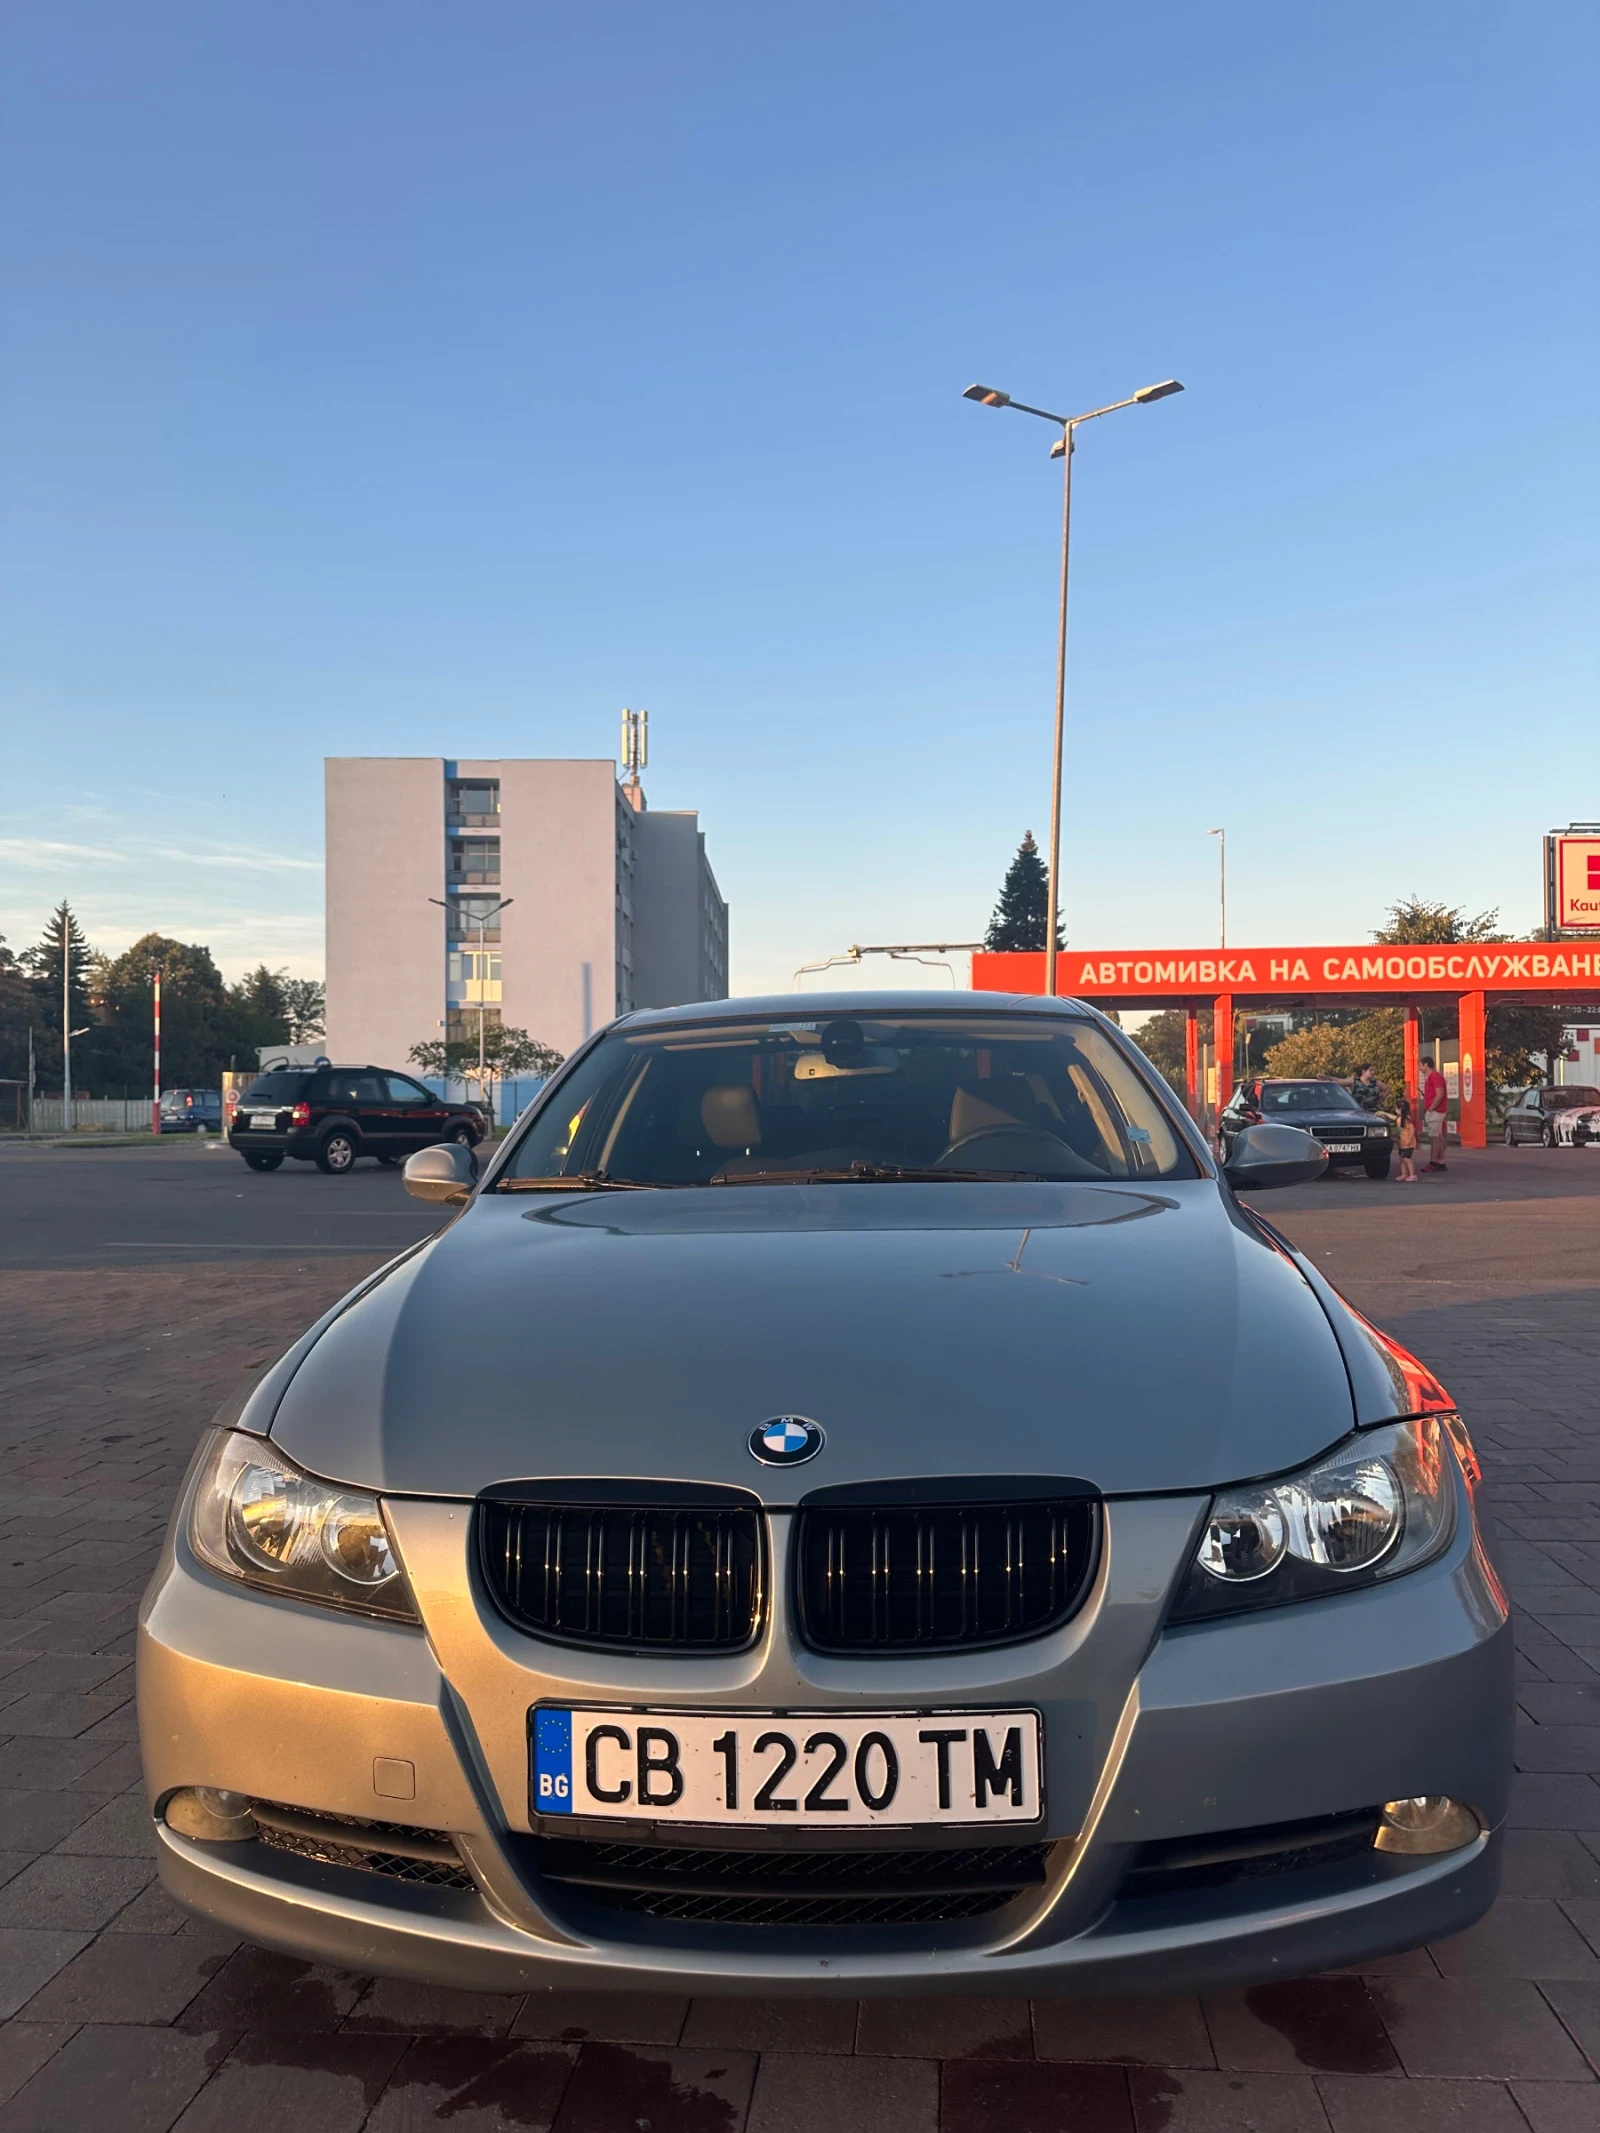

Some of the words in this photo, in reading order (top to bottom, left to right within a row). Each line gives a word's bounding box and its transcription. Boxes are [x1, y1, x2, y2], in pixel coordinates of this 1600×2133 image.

[1570, 898, 1600, 912] Kau
[1079, 959, 1257, 985] АВТОМИВКА
[1270, 958, 1311, 982] НА
[758, 1417, 816, 1431] BMW
[584, 1723, 684, 1807] CB
[712, 1729, 900, 1812] 1220
[917, 1727, 1023, 1810] TM
[539, 1772, 570, 1799] BG
